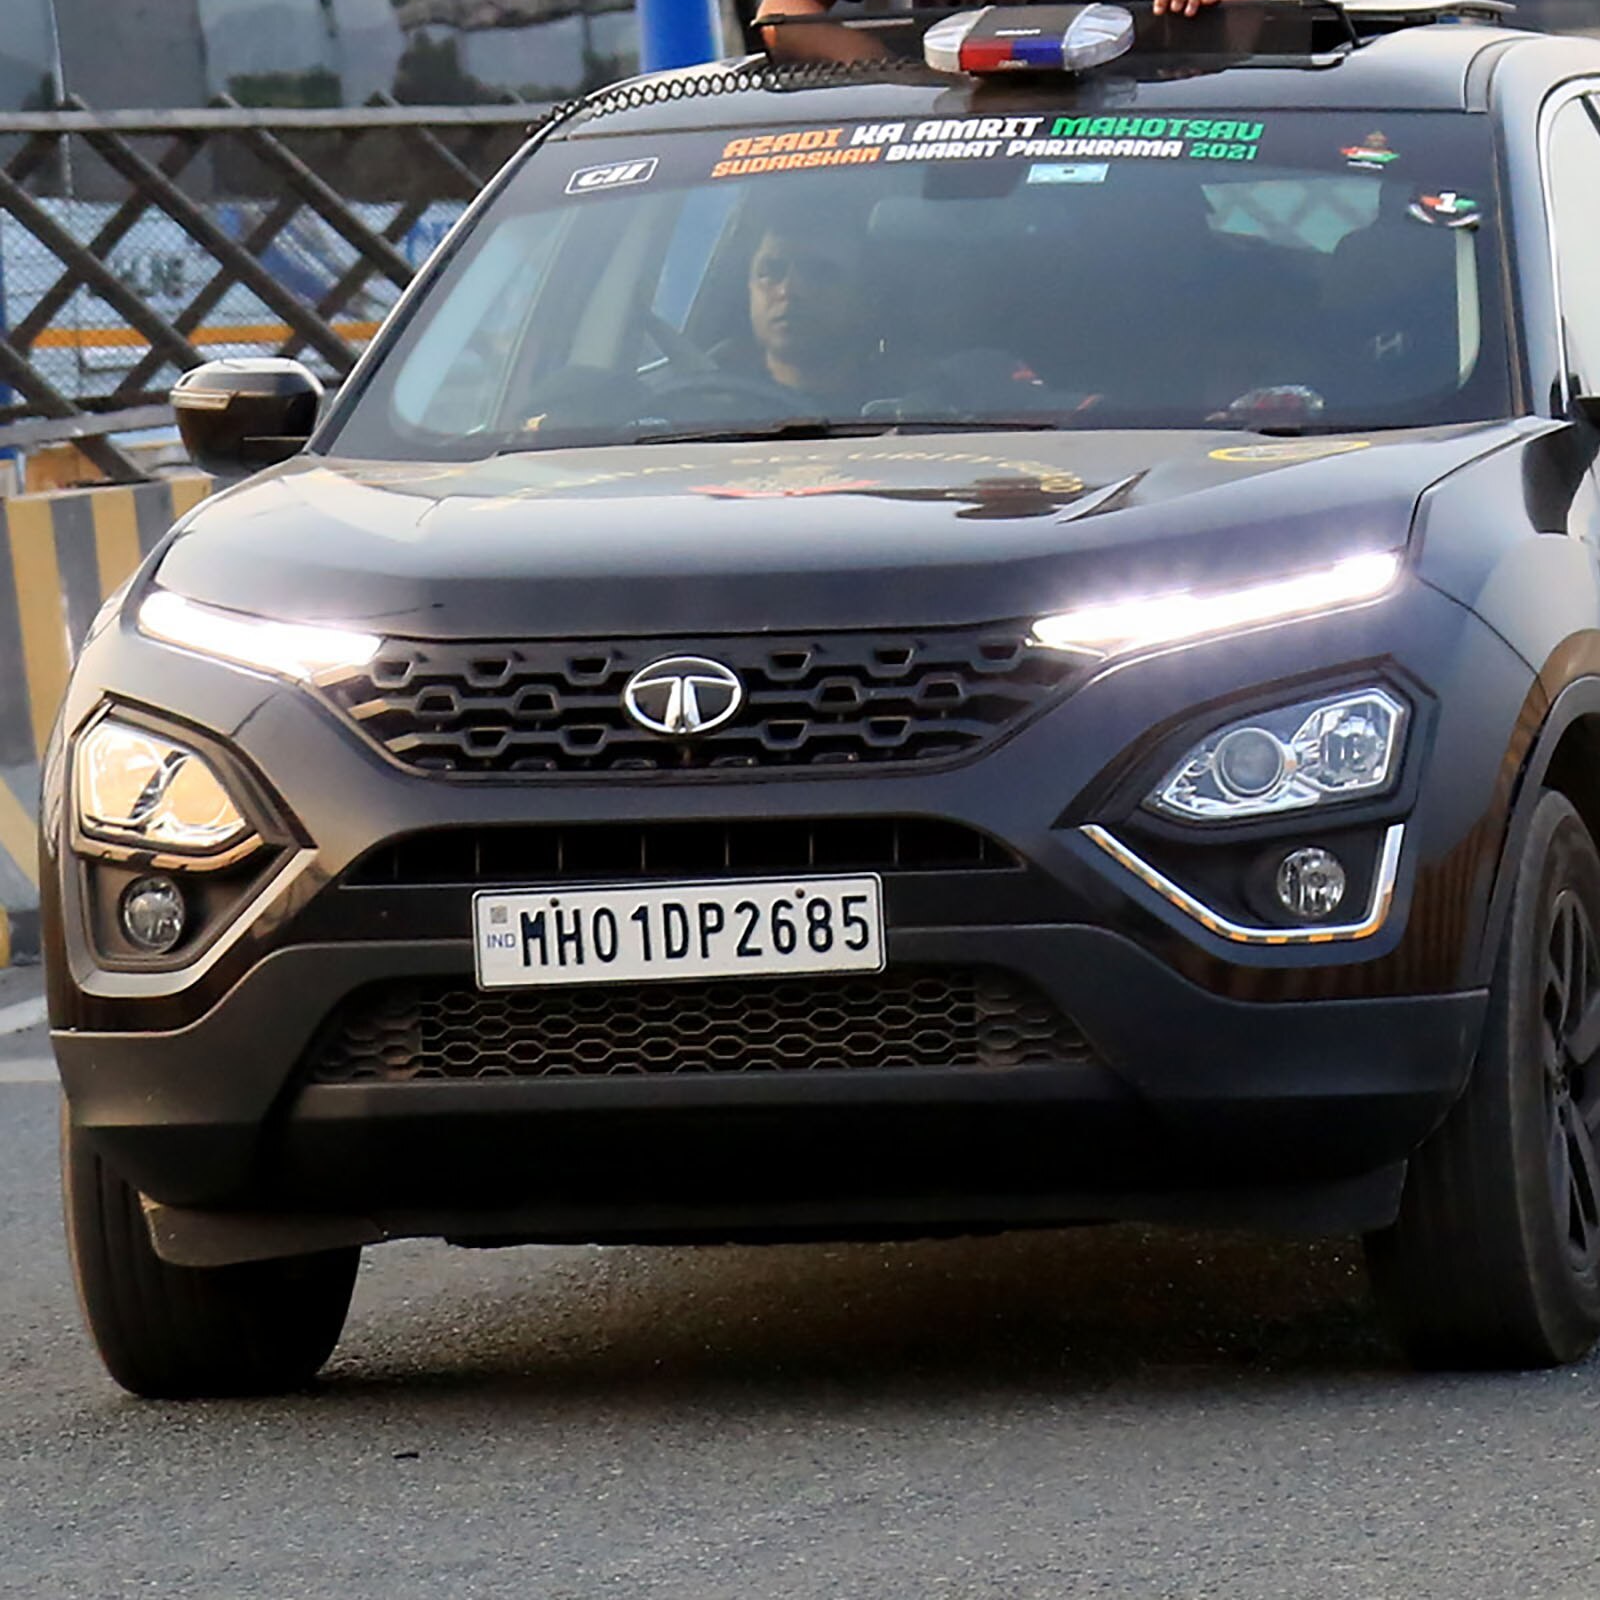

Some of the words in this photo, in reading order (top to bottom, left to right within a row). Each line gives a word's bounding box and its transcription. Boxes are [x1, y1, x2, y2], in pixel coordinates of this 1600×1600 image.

[711, 146, 882, 179] SUDARSHAN
[885, 140, 1004, 162] BHARAT
[1005, 139, 1184, 158] PARIKRAMA
[1189, 142, 1258, 161] 2021
[722, 127, 844, 160] AZADI
[850, 122, 906, 147] KA
[911, 116, 1045, 143] AMRIT
[486, 932, 516, 949] IND
[518, 894, 870, 968] MH01DP2685
